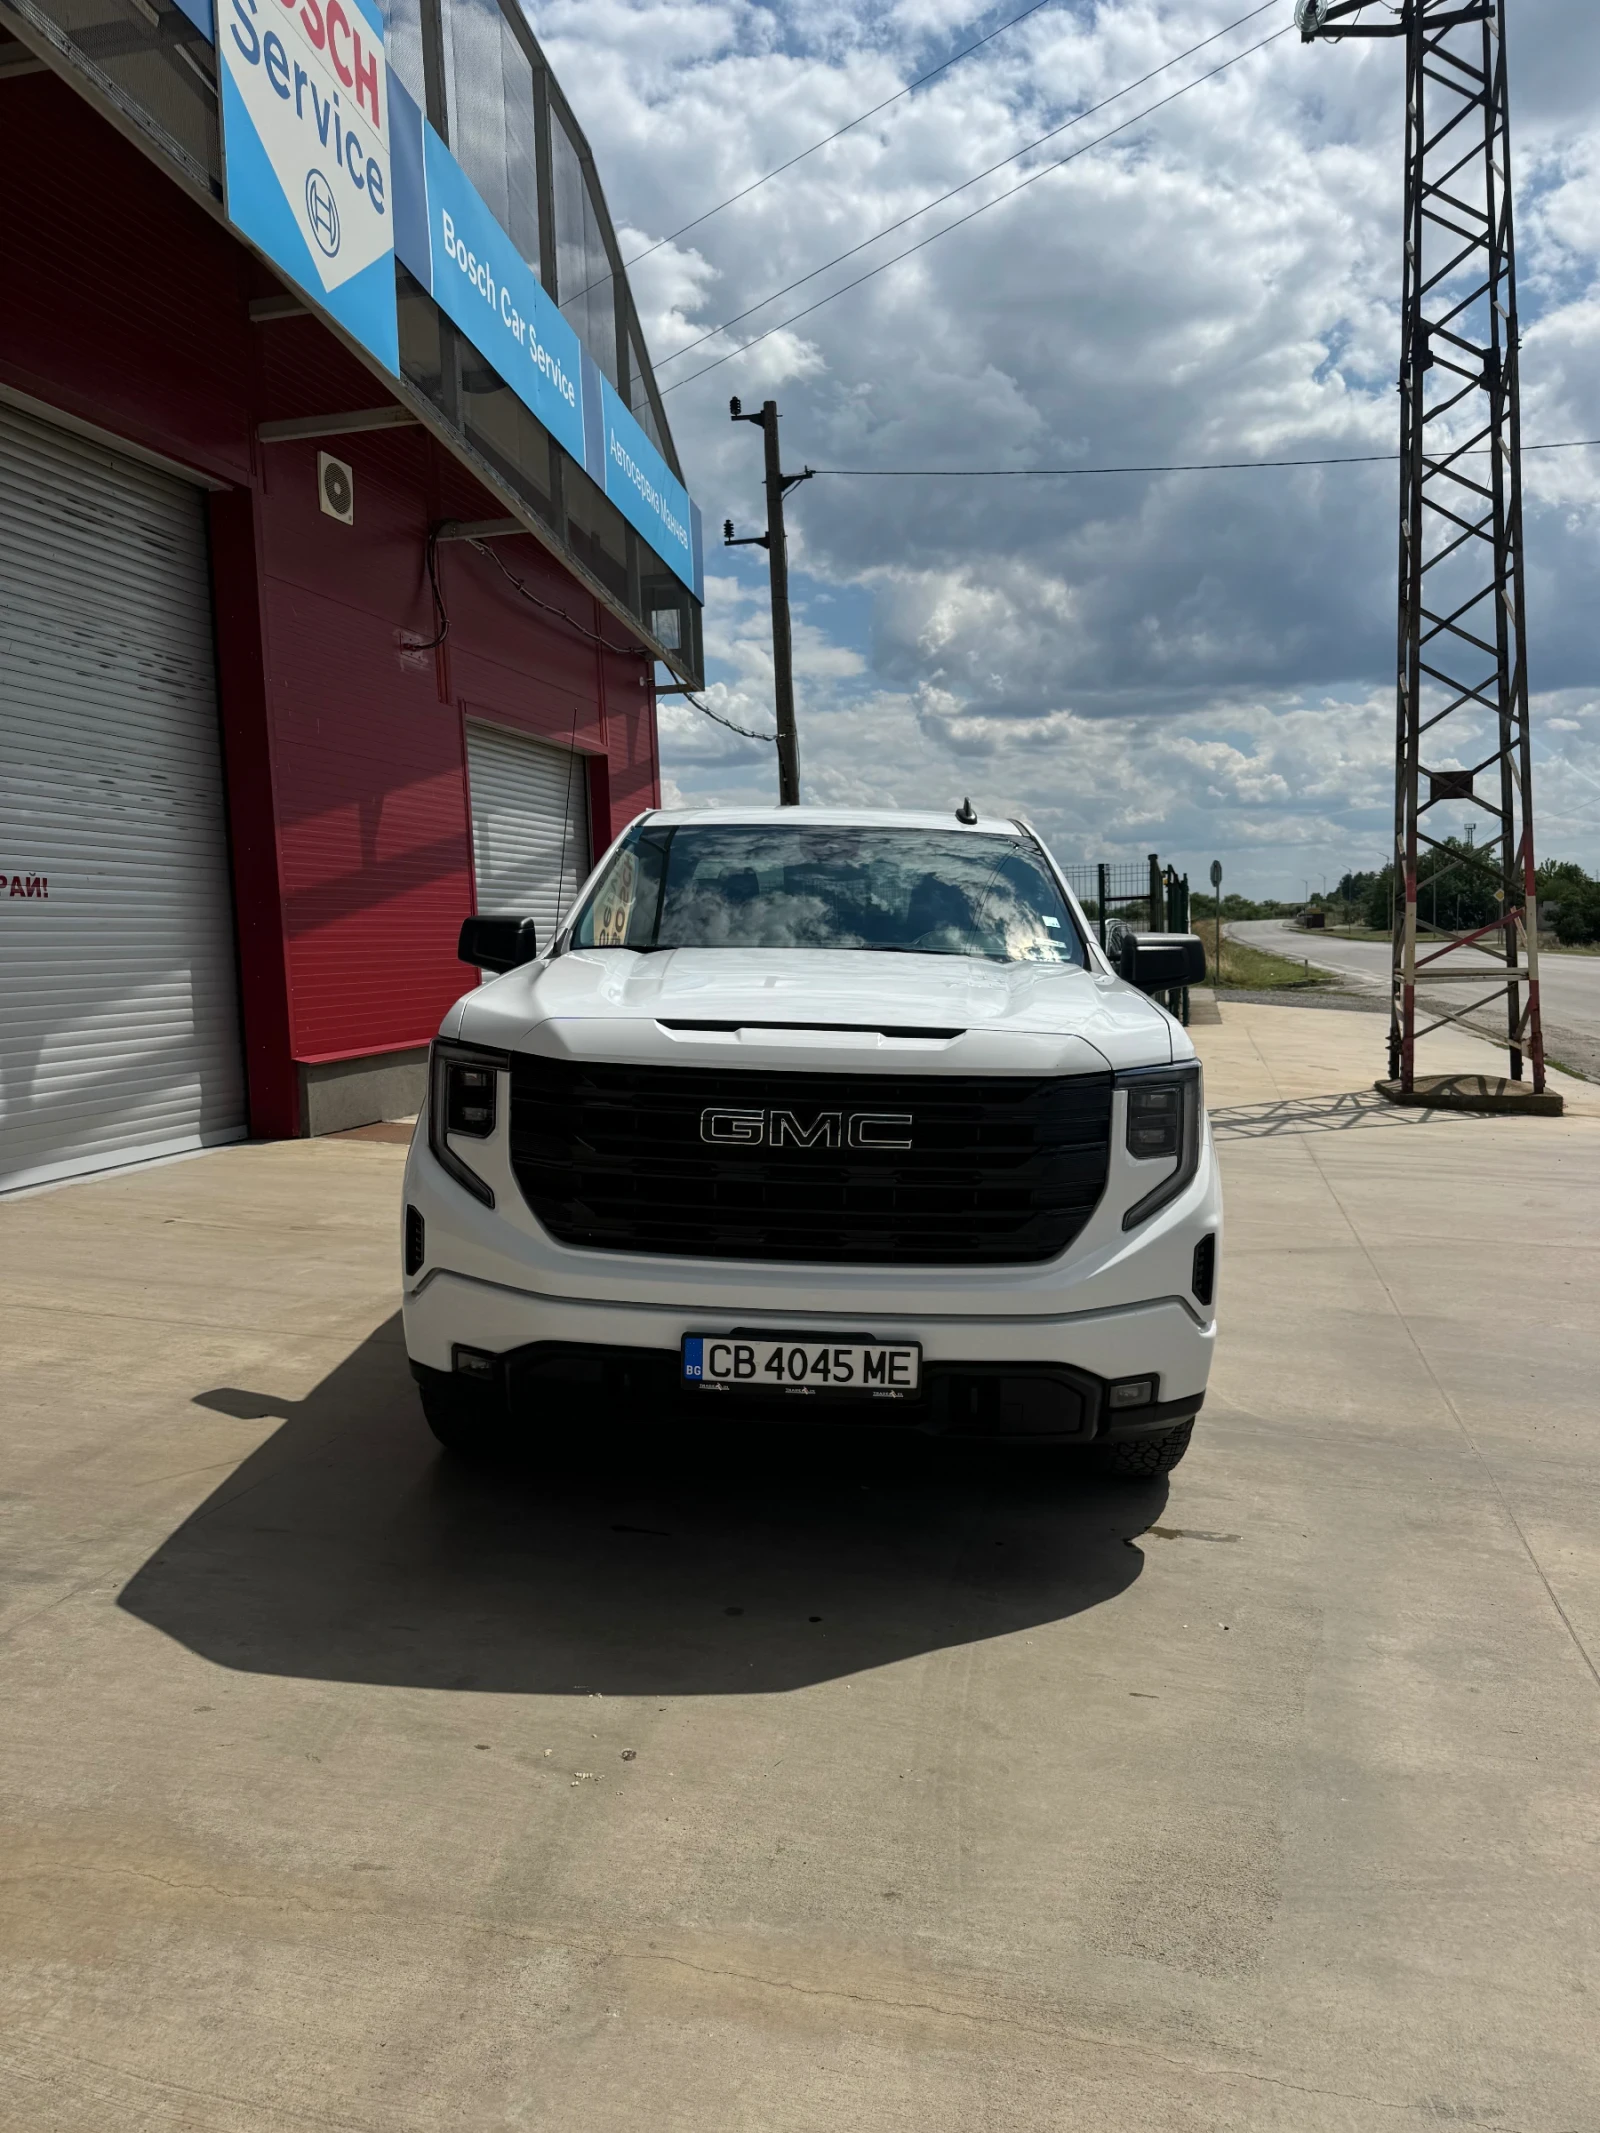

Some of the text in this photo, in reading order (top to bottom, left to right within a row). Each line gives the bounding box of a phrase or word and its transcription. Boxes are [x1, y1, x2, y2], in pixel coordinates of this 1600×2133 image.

[230, 0, 385, 215] Service
[281, 0, 380, 130] SCH
[442, 208, 575, 407] Bosch Car Service
[610, 428, 688, 550] Автосервиз Манчев
[701, 1107, 912, 1149] GMC
[686, 1344, 911, 1385] BG CB 4045 ME
